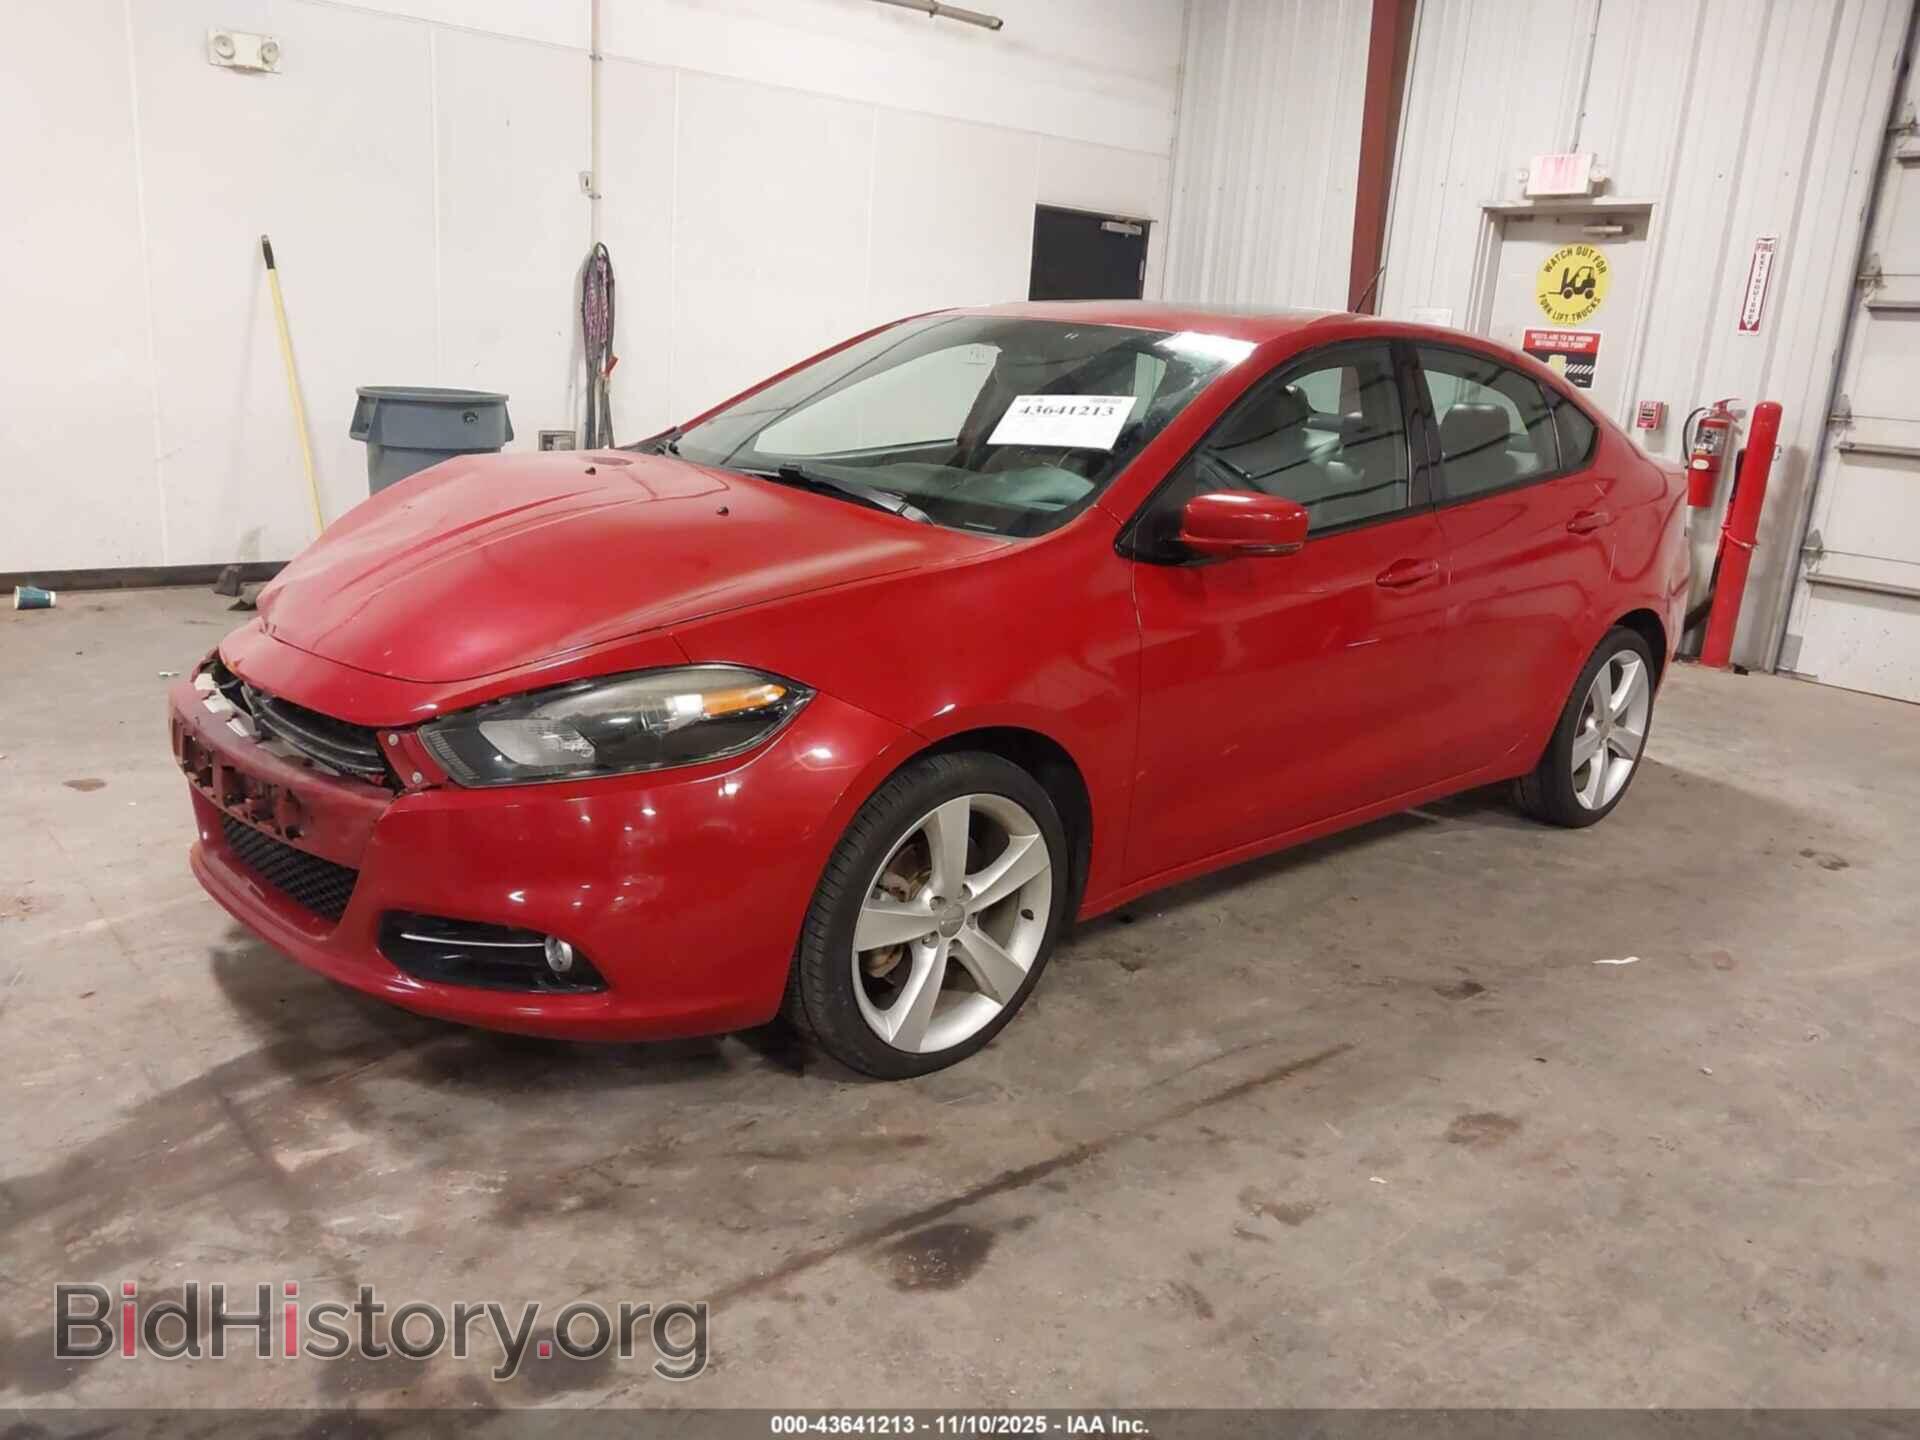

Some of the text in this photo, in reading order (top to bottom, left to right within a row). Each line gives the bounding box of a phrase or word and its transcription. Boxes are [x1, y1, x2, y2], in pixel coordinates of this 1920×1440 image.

[1756, 243, 1775, 253] FIRE
[1544, 246, 1607, 274] WATCH OUT FOR
[1539, 294, 1601, 322] FORK LIFT TRUCKS
[1018, 405, 1115, 417] 43641213
